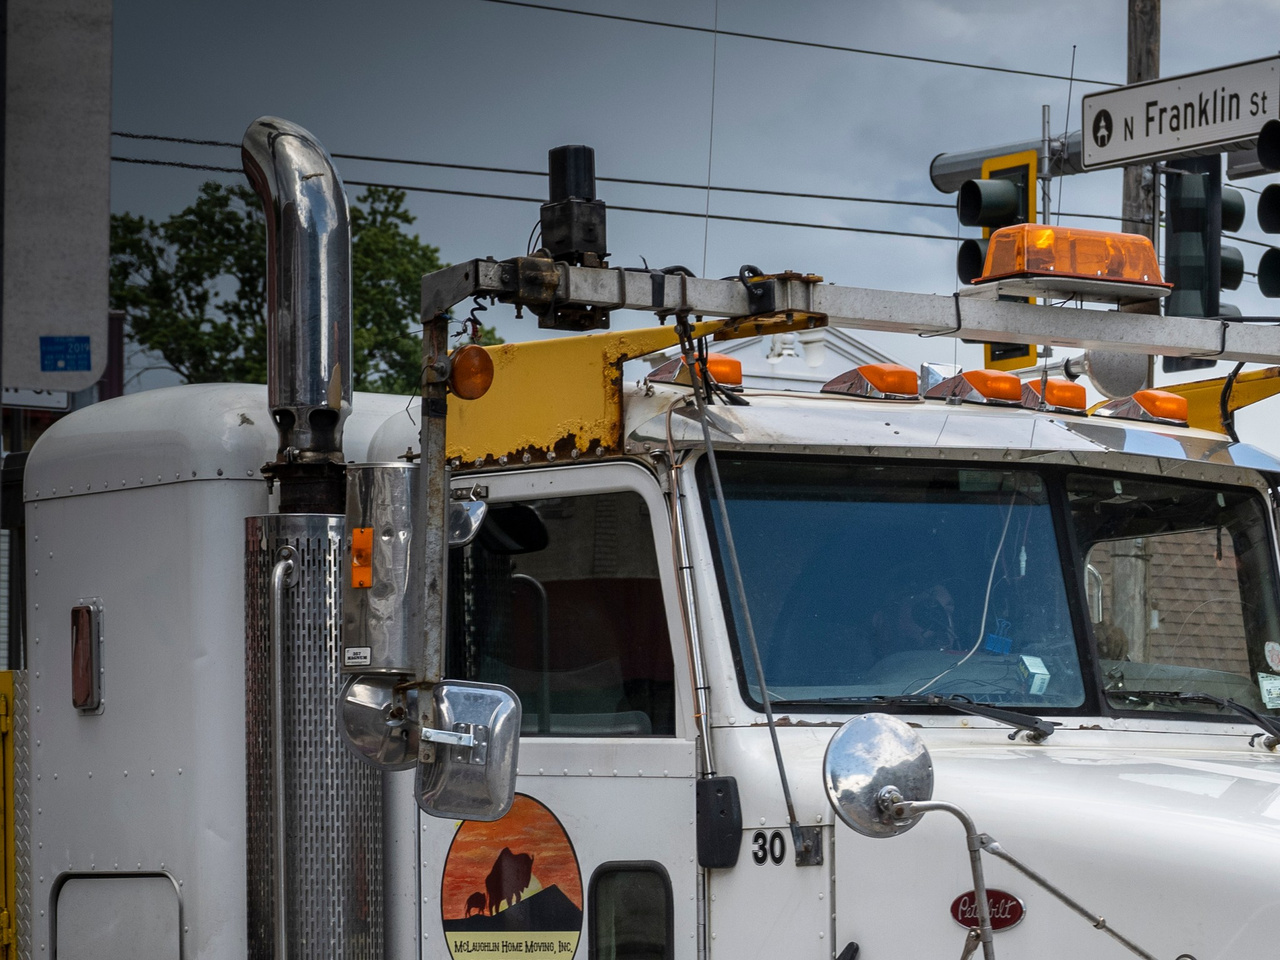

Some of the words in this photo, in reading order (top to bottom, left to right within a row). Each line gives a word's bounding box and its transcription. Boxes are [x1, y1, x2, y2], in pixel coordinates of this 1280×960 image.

[1124, 116, 1134, 141] N
[1145, 86, 1240, 137] Franklin
[1249, 90, 1268, 117] St
[752, 829, 787, 867] 30
